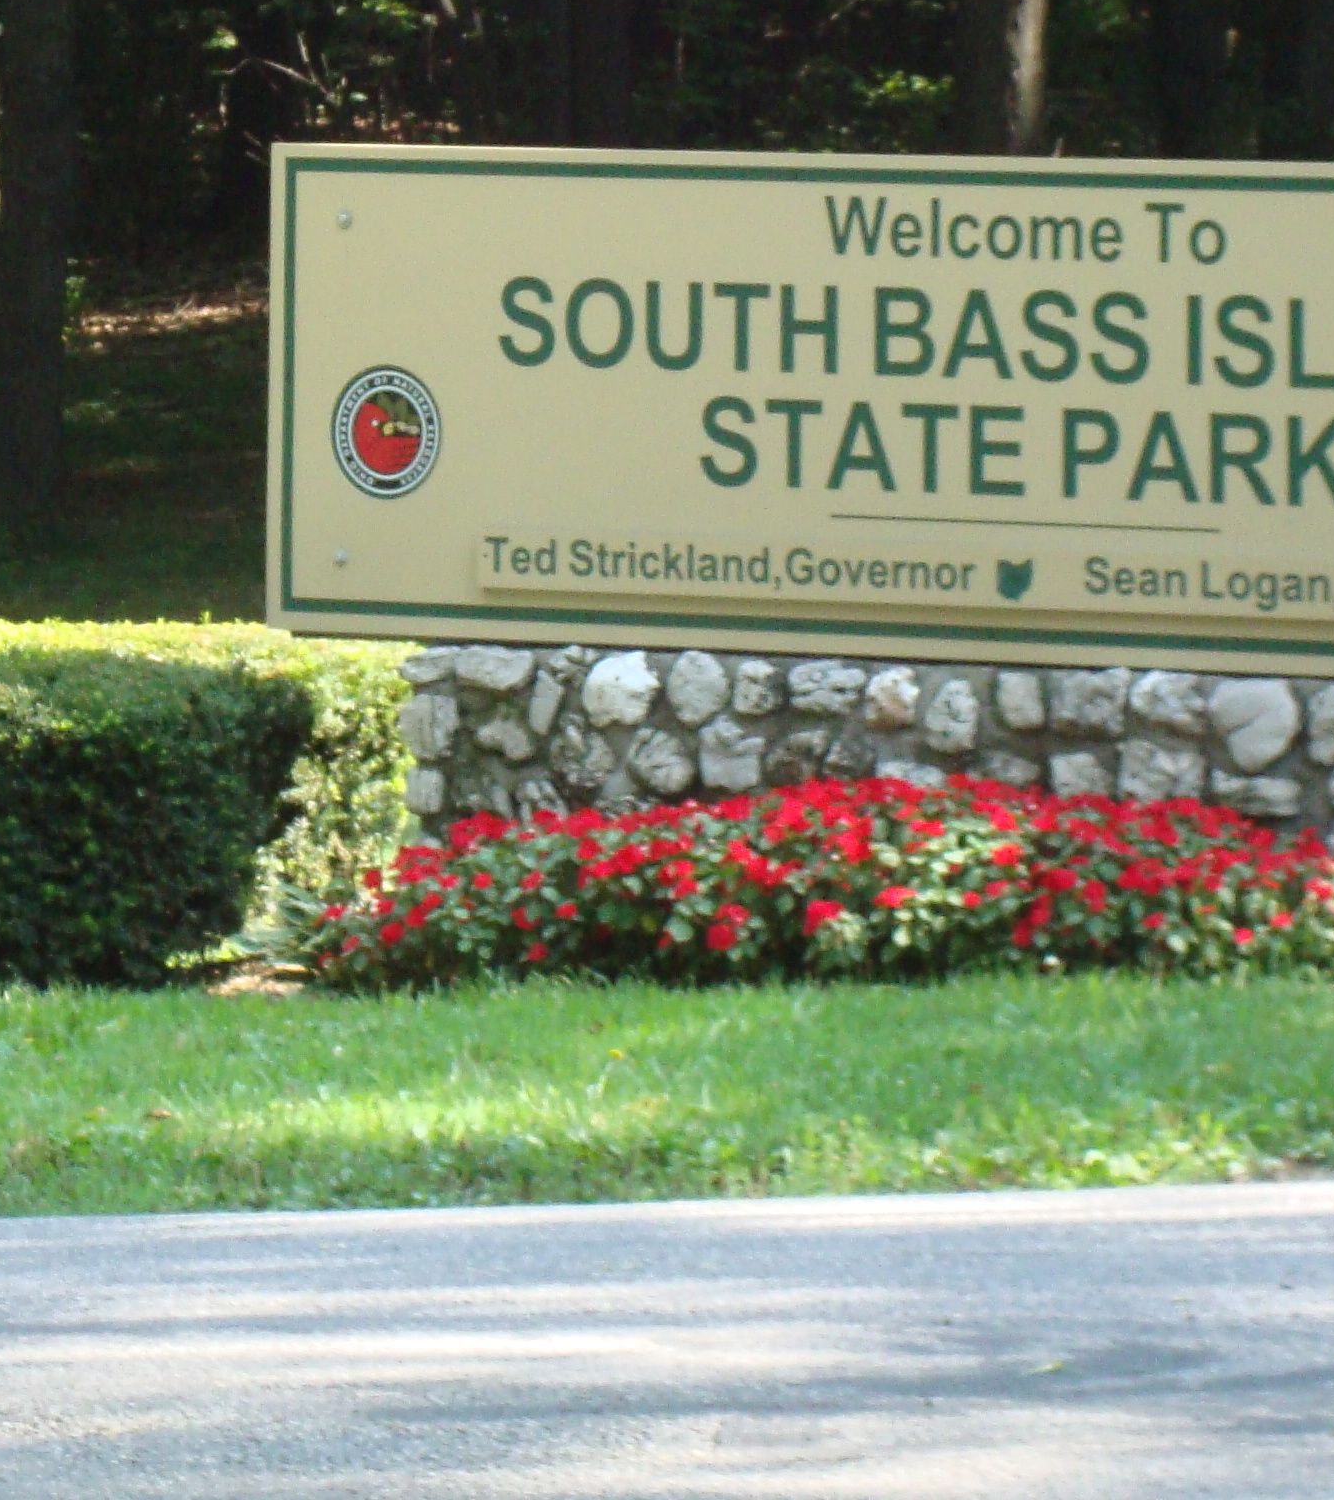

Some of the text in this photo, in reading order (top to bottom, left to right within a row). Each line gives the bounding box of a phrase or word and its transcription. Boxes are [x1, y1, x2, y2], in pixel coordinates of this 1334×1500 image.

[825, 195, 1229, 267] Welcome To
[498, 276, 840, 375] SOUTH
[873, 286, 1151, 386] BASS
[699, 395, 1027, 498] STATE
[484, 536, 557, 576] Ted
[1084, 555, 1188, 598] Sean
